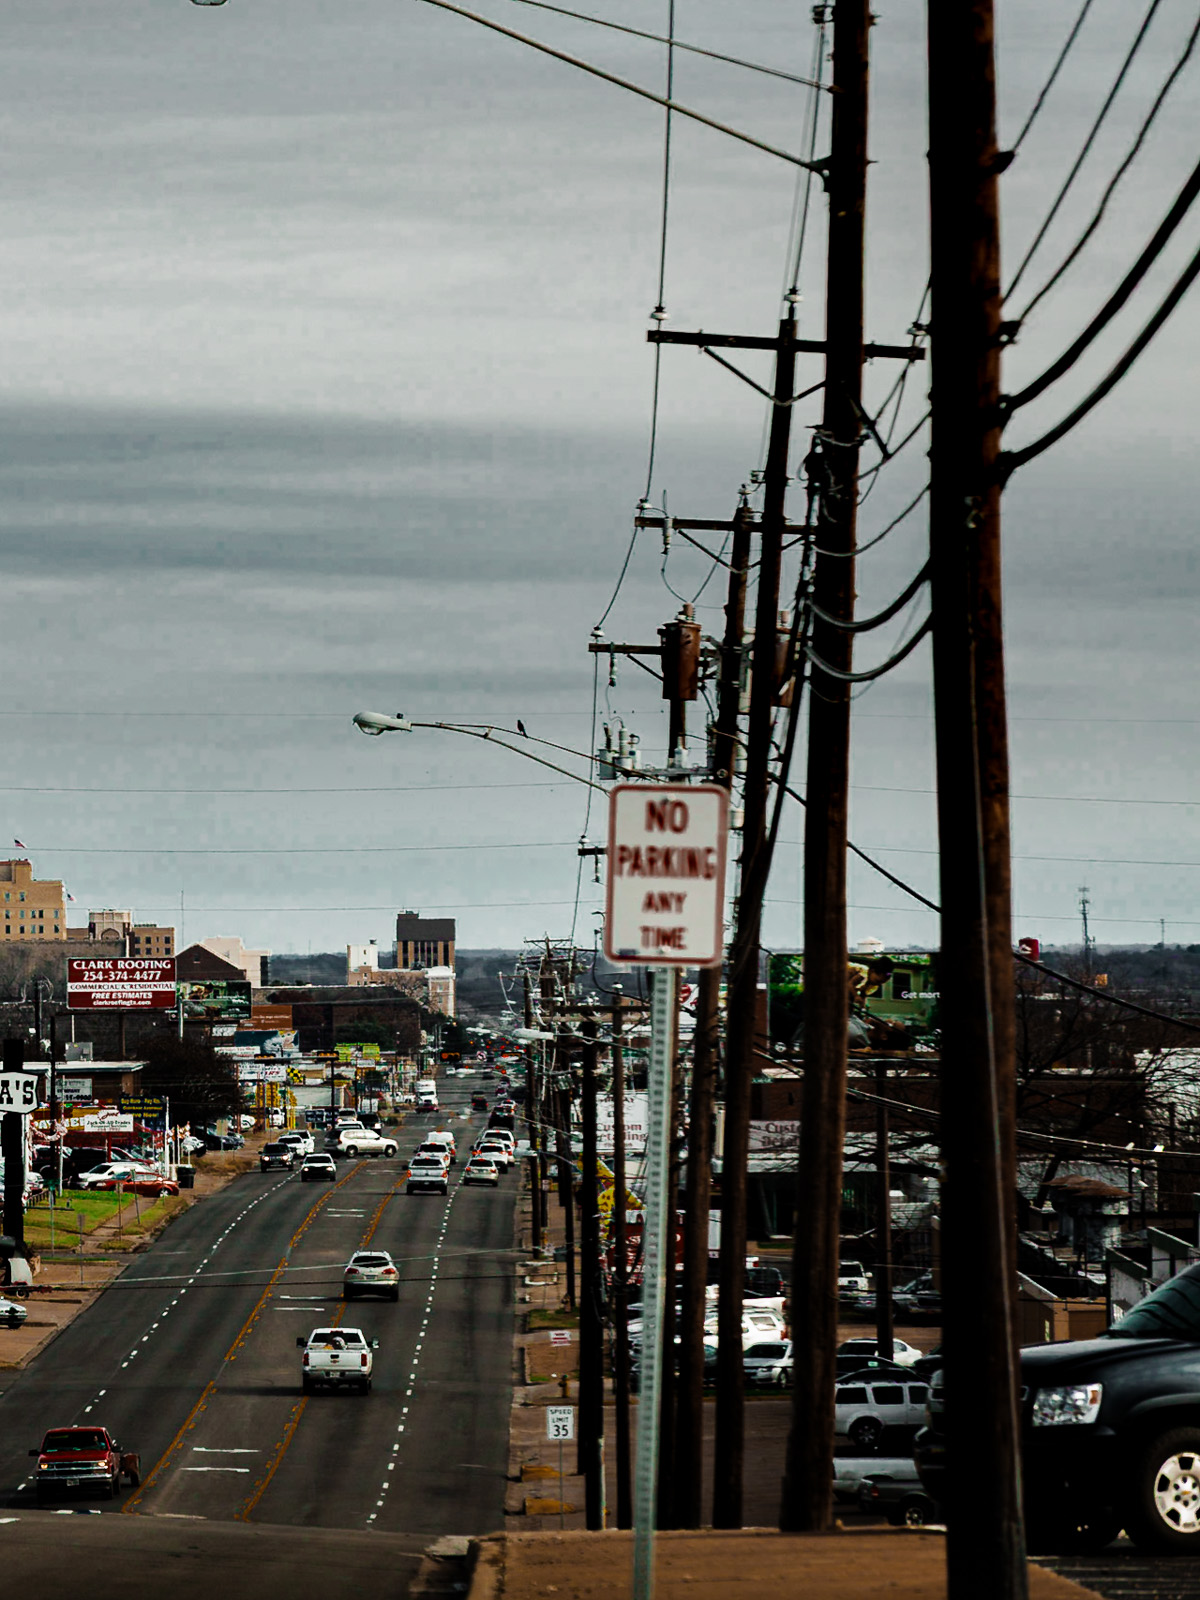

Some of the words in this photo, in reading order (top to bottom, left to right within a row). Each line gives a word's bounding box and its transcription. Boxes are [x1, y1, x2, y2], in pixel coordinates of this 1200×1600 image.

[645, 799, 690, 833] NO
[613, 844, 717, 880] PARKING
[641, 890, 687, 913] ANY
[639, 925, 688, 949] TIME
[73, 960, 113, 969] CLARK
[117, 960, 171, 969] ROOFING
[83, 971, 161, 981] 254-374-4477
[901, 991, 917, 999] Get
[553, 1424, 569, 1437] 35
